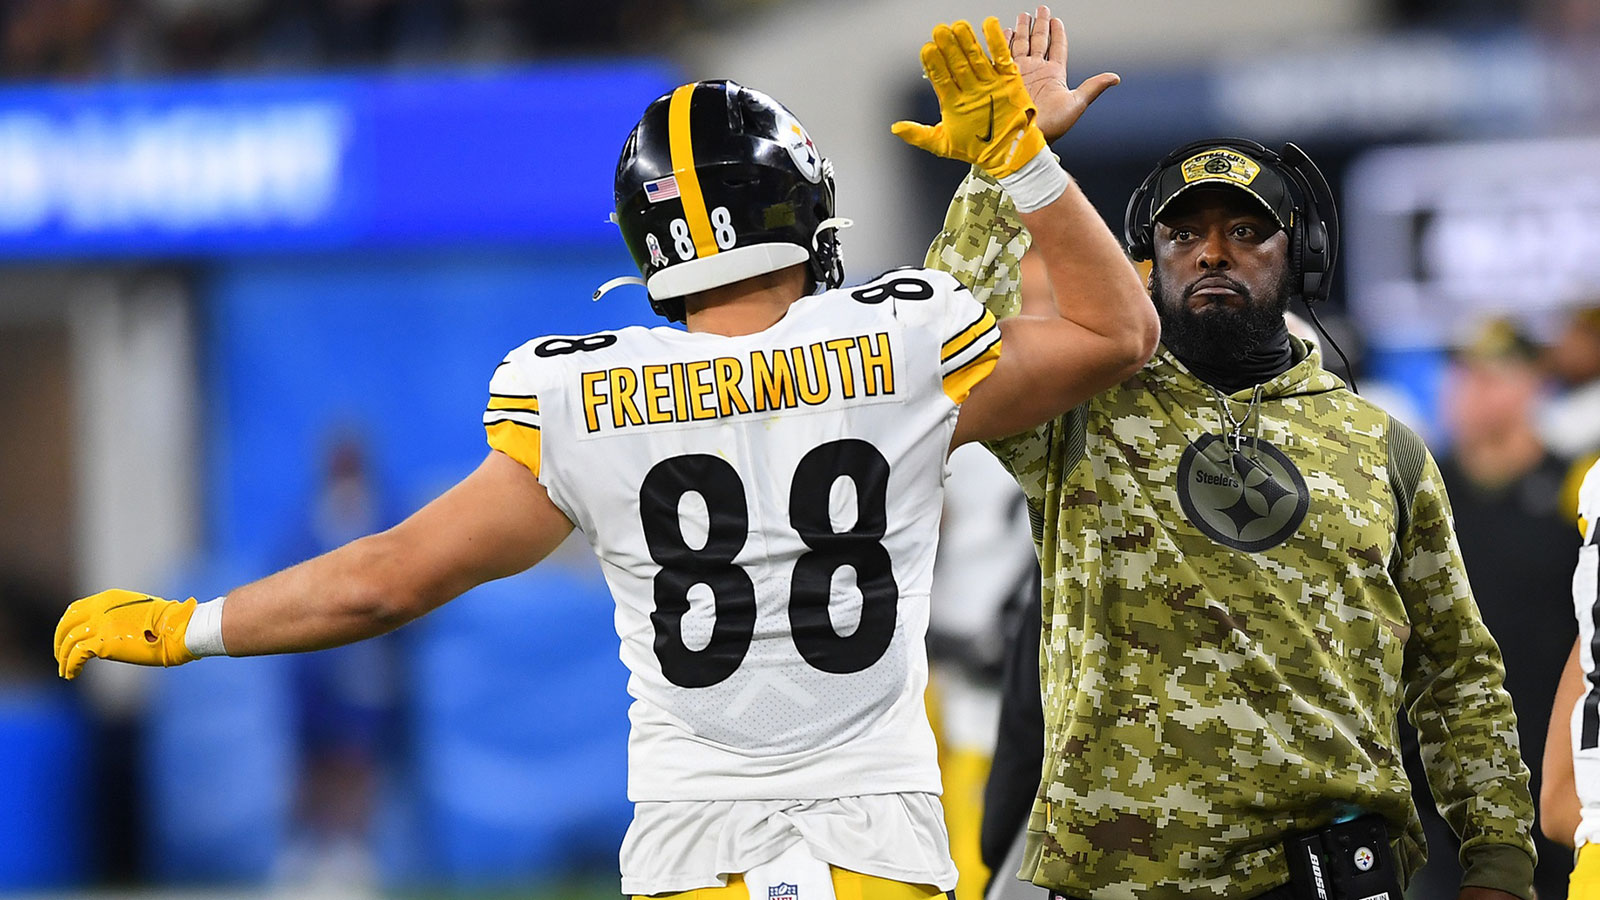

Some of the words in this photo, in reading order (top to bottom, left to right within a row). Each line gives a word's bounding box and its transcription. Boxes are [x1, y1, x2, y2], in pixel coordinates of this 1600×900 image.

[580, 332, 896, 434] FREIERMUTH
[1196, 470, 1239, 488] Steelers
[639, 438, 899, 689] 88
[1307, 845, 1328, 900] BOSE
